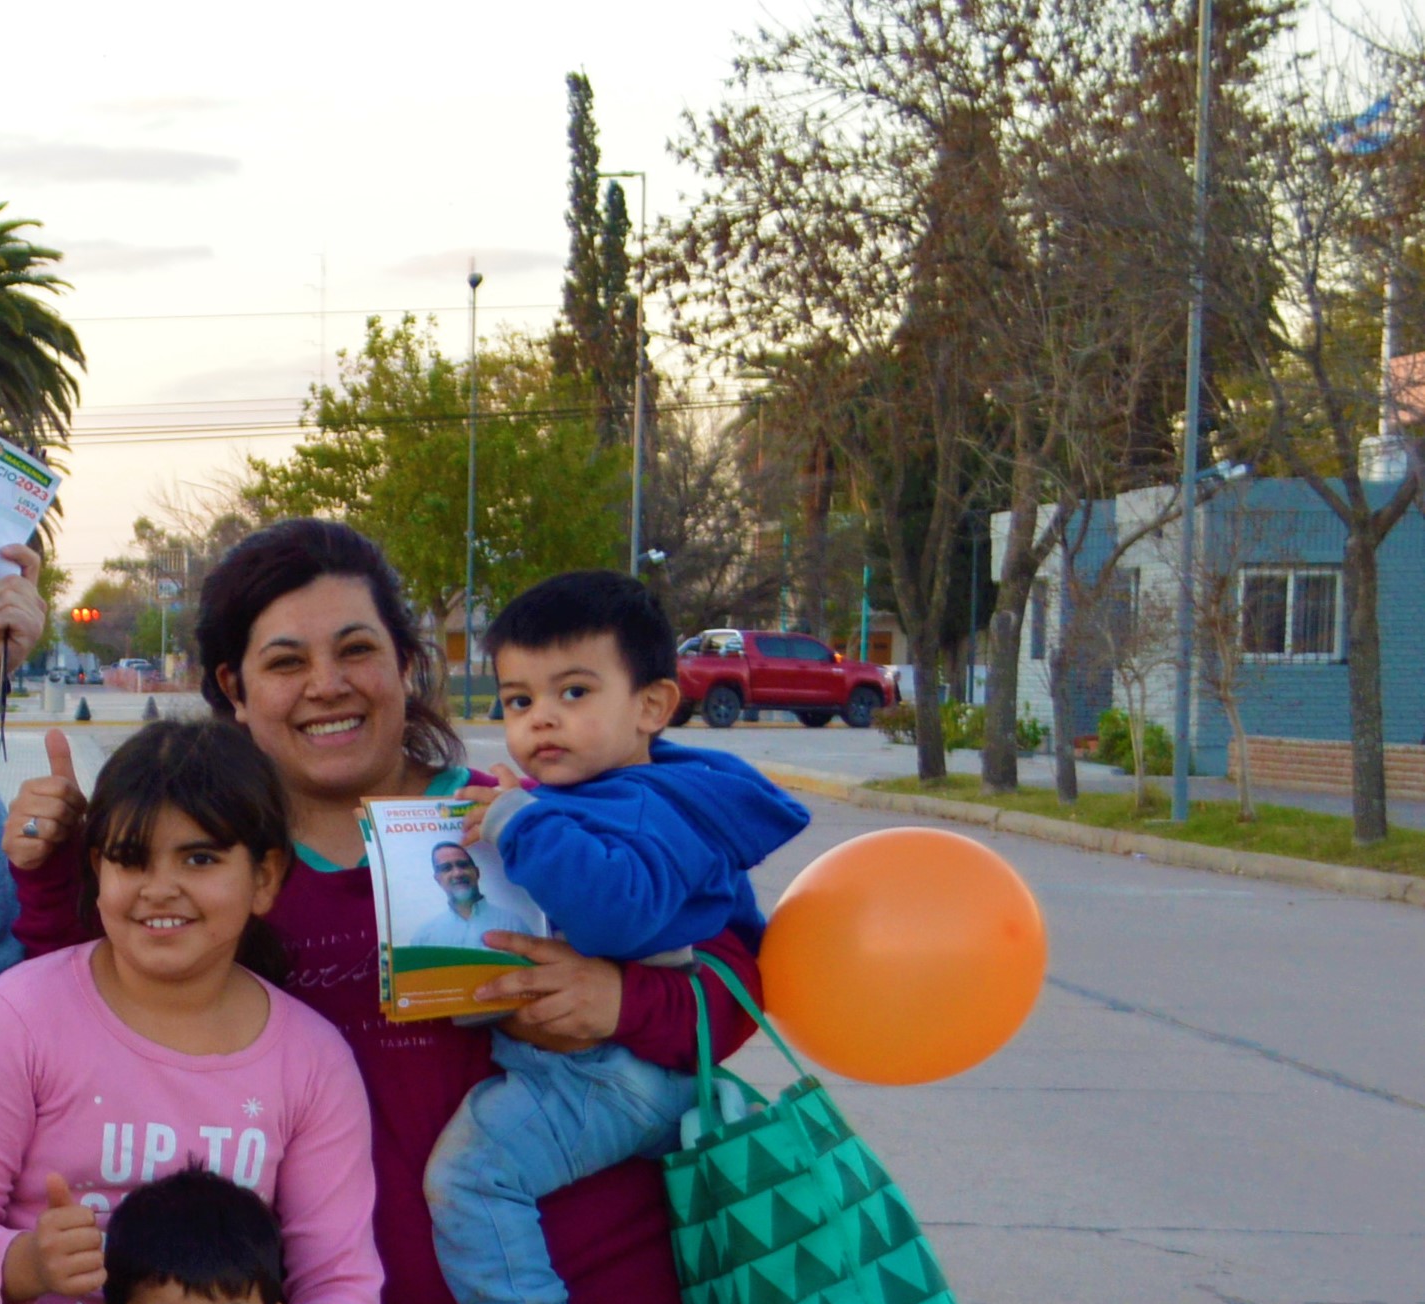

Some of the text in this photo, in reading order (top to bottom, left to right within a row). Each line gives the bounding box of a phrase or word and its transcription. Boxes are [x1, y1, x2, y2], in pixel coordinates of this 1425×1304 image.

[18, 496, 40, 513] LISTA
[386, 808, 436, 817] PROYECTO
[100, 1122, 267, 1190] UP TO
